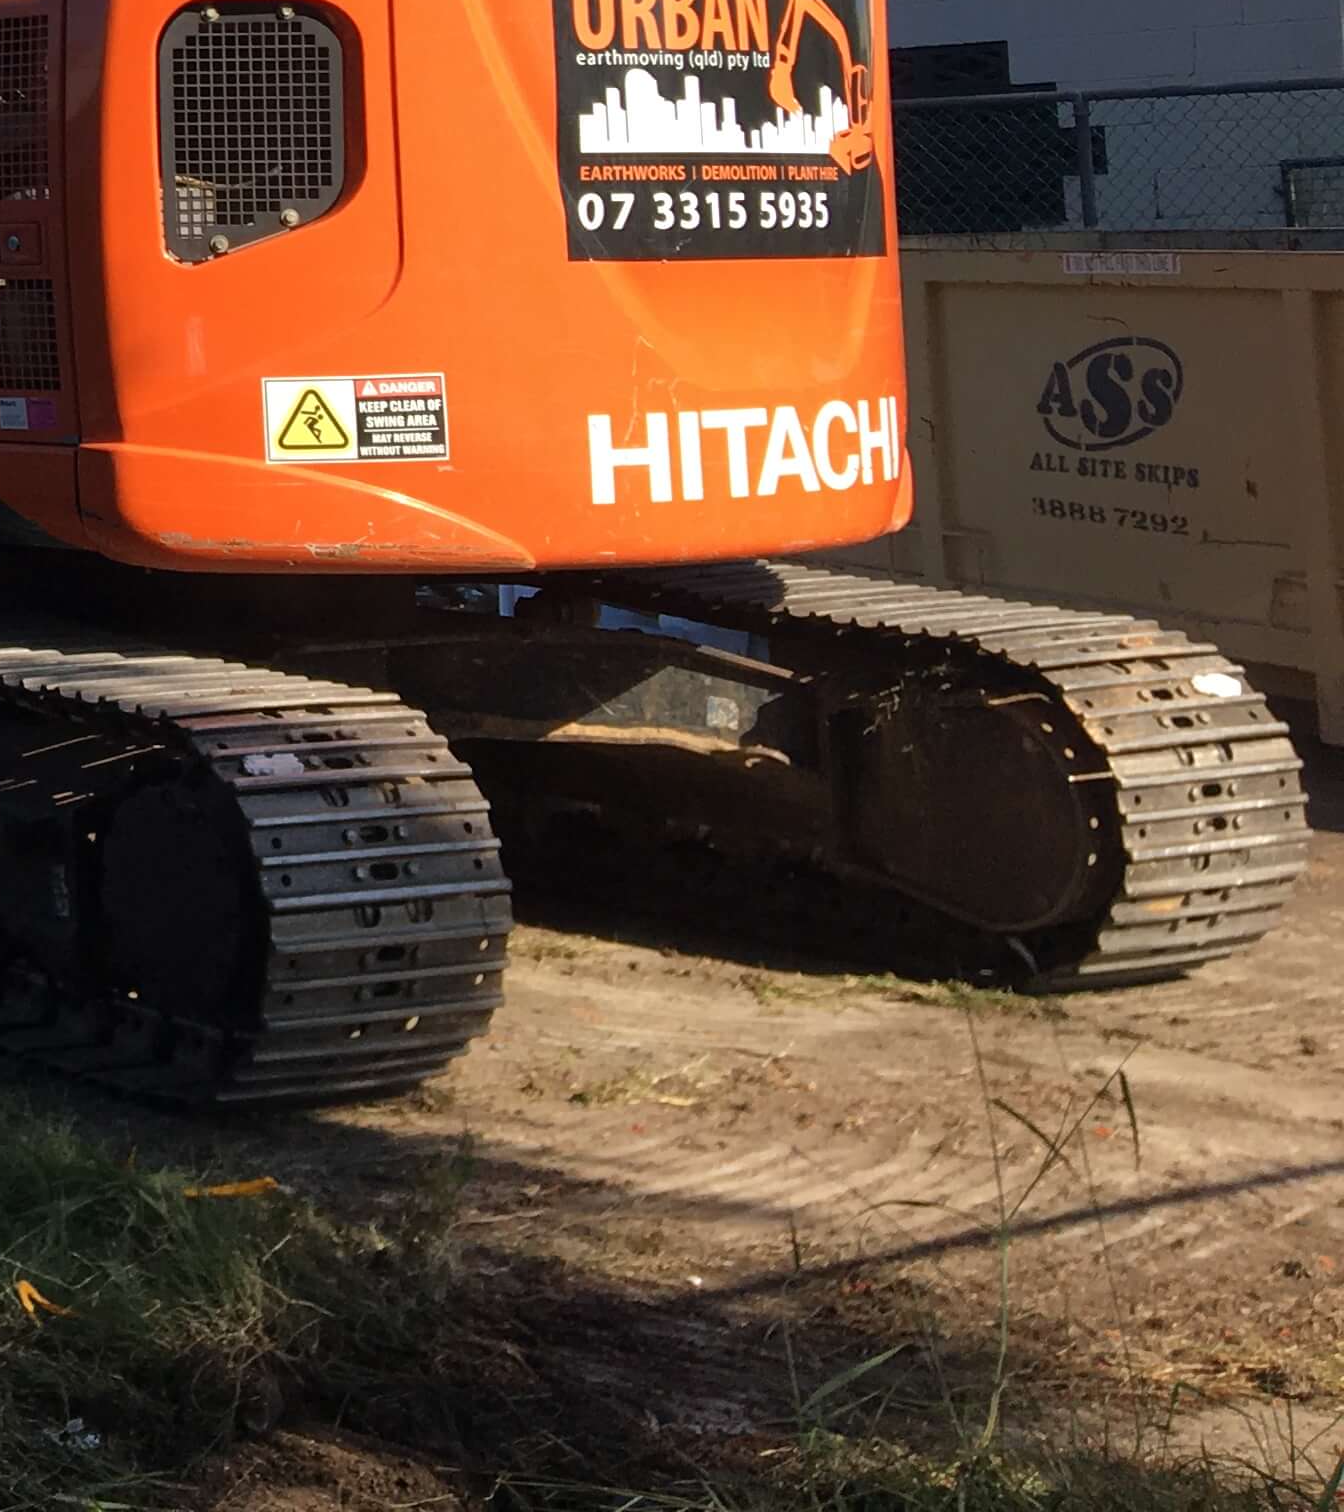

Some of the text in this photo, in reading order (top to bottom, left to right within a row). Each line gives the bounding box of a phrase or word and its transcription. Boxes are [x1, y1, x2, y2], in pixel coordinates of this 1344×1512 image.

[576, 50, 771, 71] earthmoving (qld) pty ltd
[579, 165, 839, 181] EARTHWORKS DEMOLITION PLANT HIRE
[577, 191, 831, 231] 07 3315 5935
[379, 381, 436, 394] DANGER
[358, 398, 442, 413] KEEP CLEAR OF
[366, 414, 438, 428] SWING AREA
[372, 432, 433, 443] MAY REVERSE
[359, 444, 445, 457] WITHOUT WARNING
[587, 396, 899, 505] HITACHI
[1030, 452, 1199, 488] ALL SITE SKIPS
[1032, 497, 1190, 536] 3888 7292
